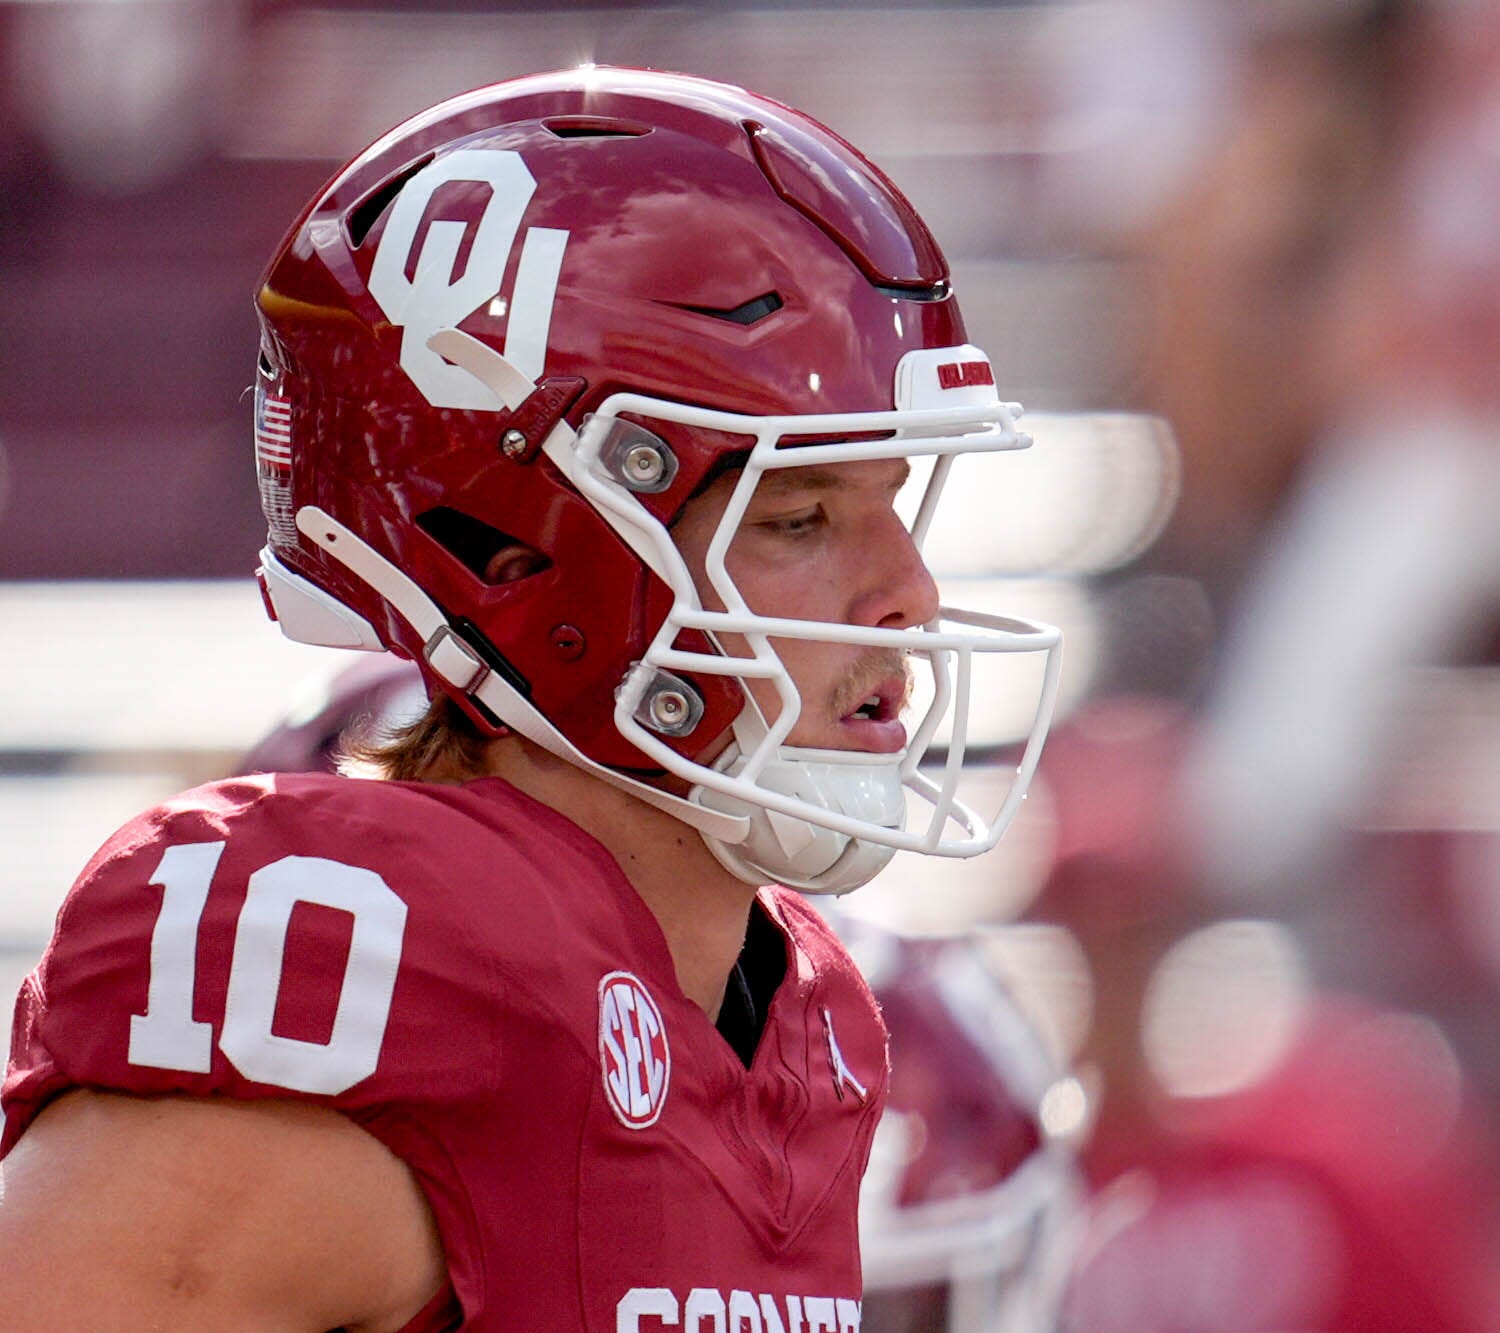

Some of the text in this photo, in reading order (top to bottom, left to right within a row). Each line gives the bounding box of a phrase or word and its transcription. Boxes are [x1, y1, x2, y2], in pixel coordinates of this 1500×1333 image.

[369, 150, 570, 411] OU
[128, 841, 408, 1096] 10
[602, 983, 665, 1117] SEC
